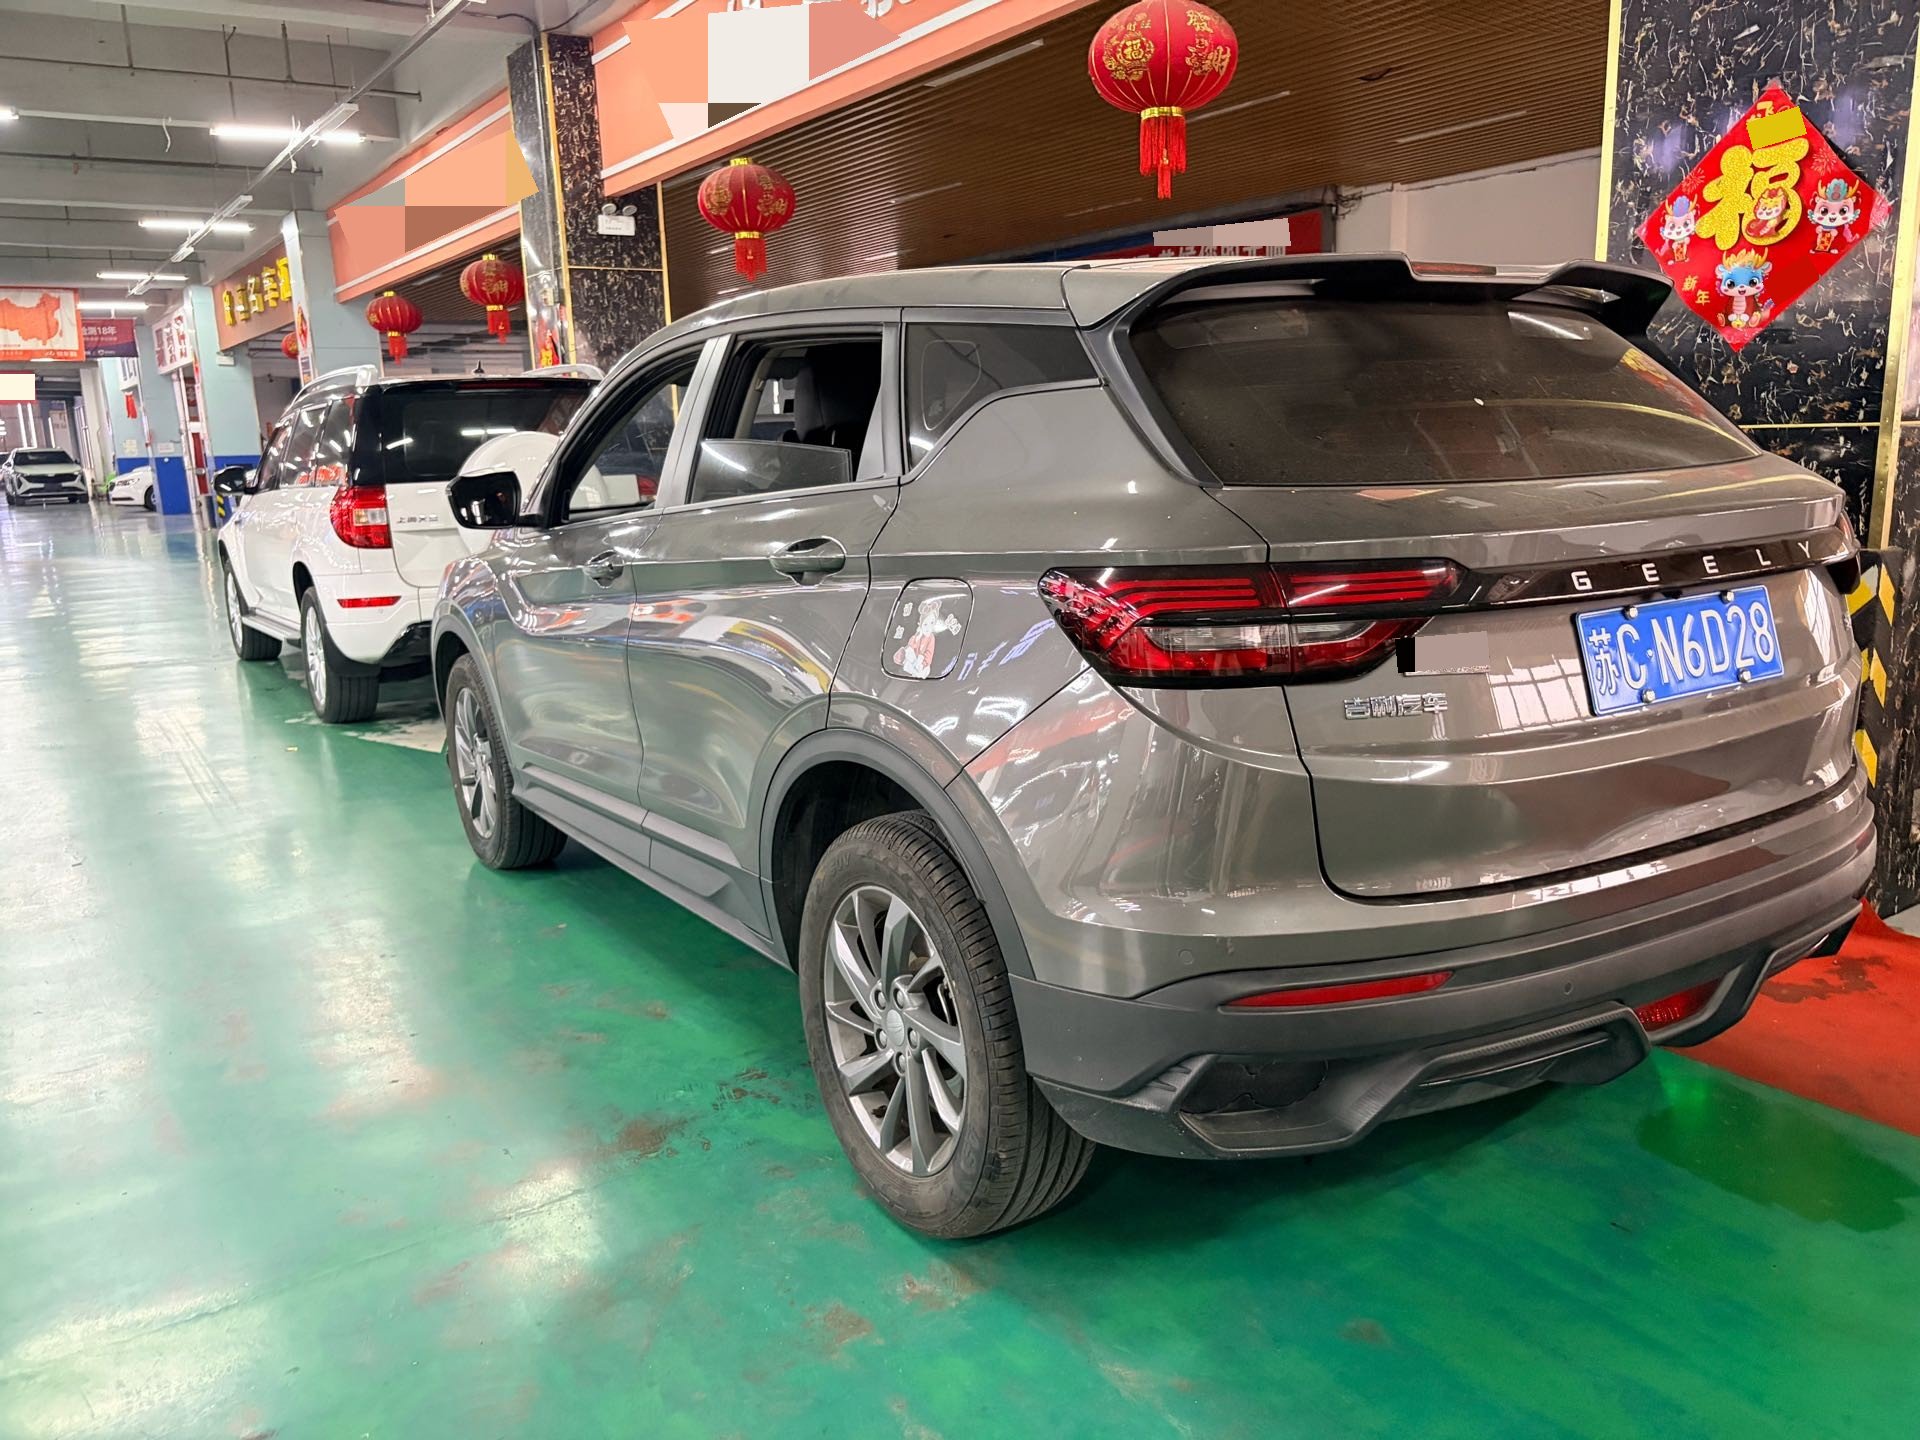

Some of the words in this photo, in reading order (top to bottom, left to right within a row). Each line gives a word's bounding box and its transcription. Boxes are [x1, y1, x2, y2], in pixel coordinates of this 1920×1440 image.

[1695, 137, 1809, 250] 福
[1682, 275, 1711, 307] 新年
[1571, 541, 1811, 591] GEELY
[1343, 693, 1448, 720] 吉利汽车
